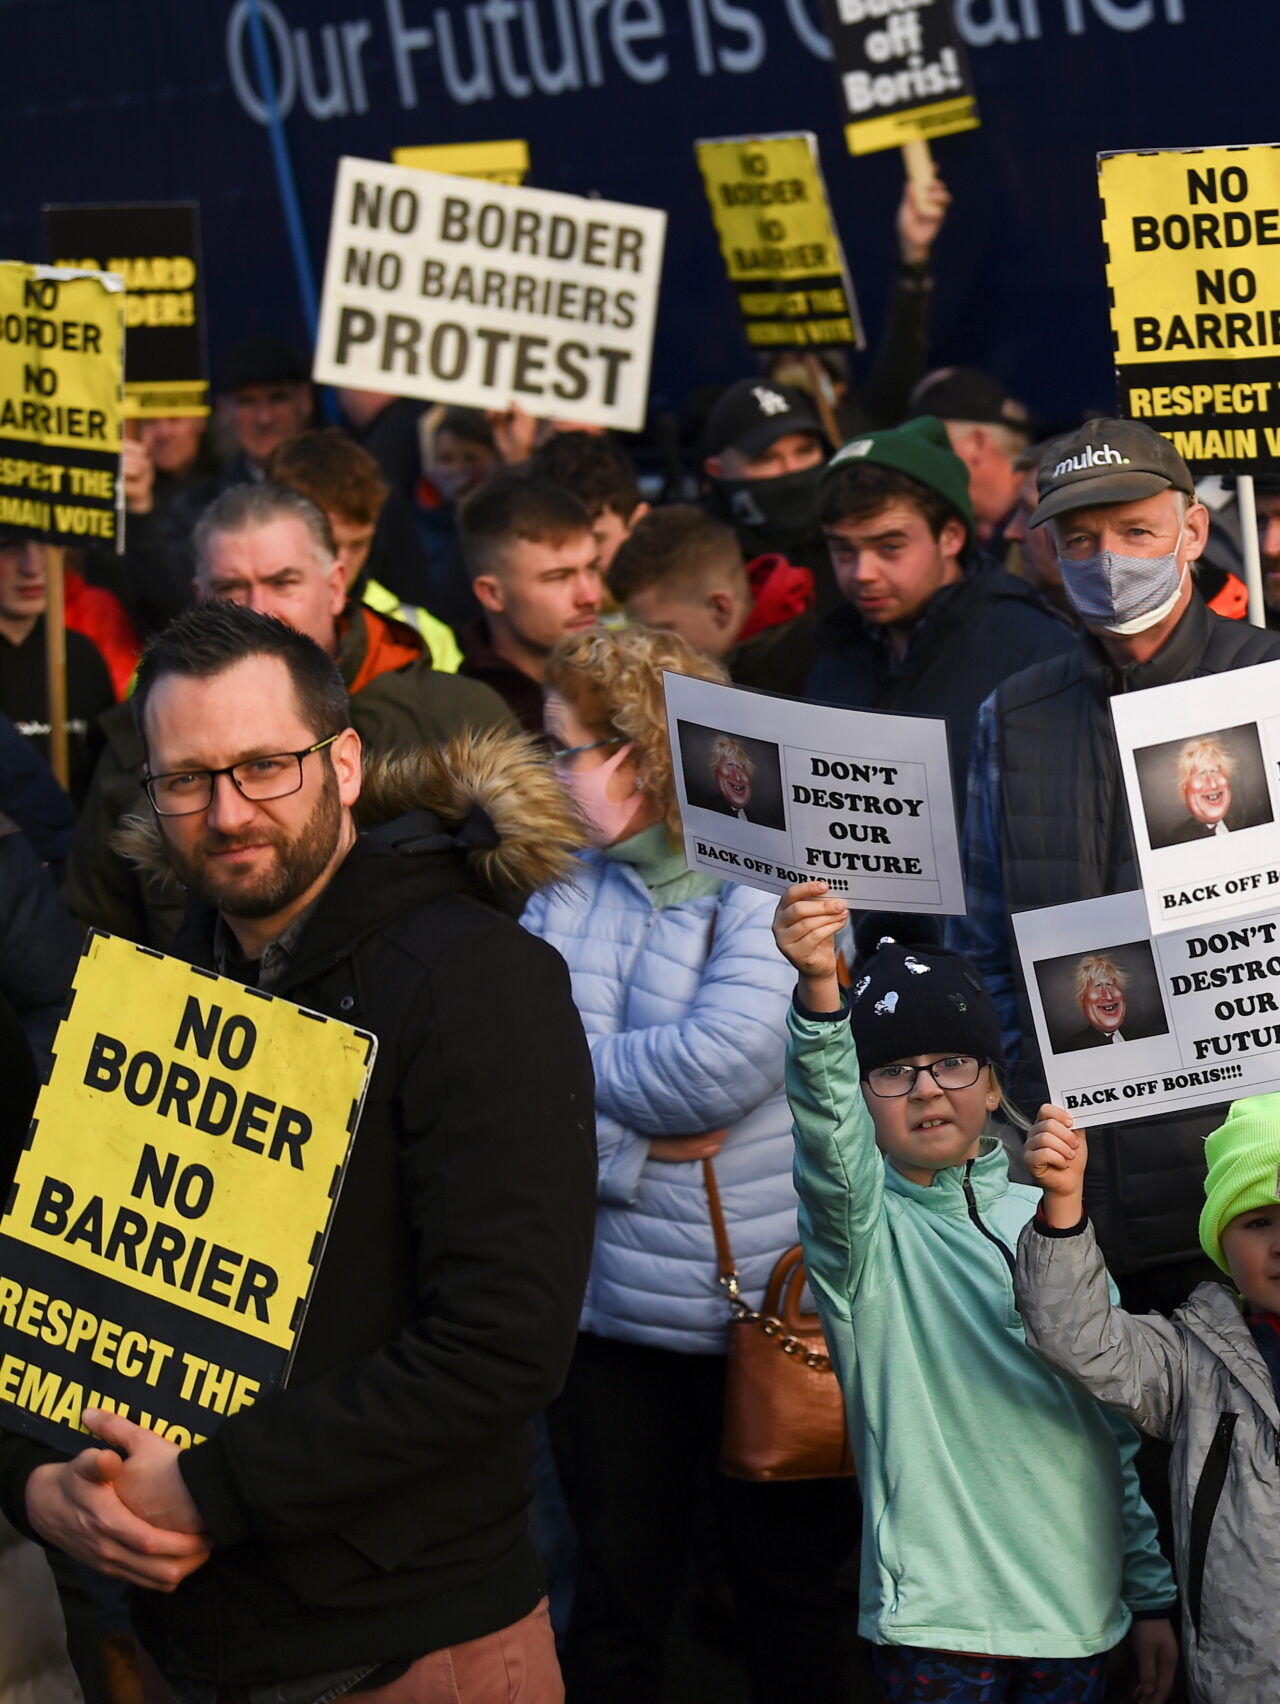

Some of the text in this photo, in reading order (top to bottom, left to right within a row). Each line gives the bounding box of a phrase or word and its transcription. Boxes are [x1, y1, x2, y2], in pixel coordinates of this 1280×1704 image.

[864, 10, 922, 63] off
[226, 0, 371, 126] Our
[842, 47, 962, 113] Boris!
[1187, 166, 1248, 205] NO
[350, 181, 645, 273] NO BORDER
[23, 279, 58, 311] NO
[343, 246, 637, 330] NO BARRIERS
[1196, 267, 1256, 305] NO
[0, 314, 102, 353] ORDER
[334, 306, 632, 407] PROTEST
[23, 364, 57, 397] NO
[1129, 382, 1271, 418] RESPECT
[0, 400, 107, 440] ARRIER
[1159, 428, 1258, 460] MAIN
[67, 465, 114, 499] THE
[54, 503, 115, 538] VOTE
[810, 757, 898, 786] DON'T
[792, 784, 924, 817] DESTROY
[829, 822, 891, 845] OUR
[696, 842, 741, 867] BACK
[743, 857, 773, 876] OFF
[805, 847, 922, 875] FUTURE
[1162, 881, 1222, 910] BACK
[1224, 872, 1262, 895] OFF
[1186, 922, 1277, 960] DON'T
[1214, 991, 1279, 1022] OUR
[174, 995, 258, 1072] NO
[83, 1032, 313, 1171] BORDER
[1065, 1064, 1243, 1110] BACK OFF BORIS!!!!
[130, 1143, 214, 1220] NO
[30, 1175, 279, 1325] BARRIER
[0, 1276, 261, 1417] RESPECT THE
